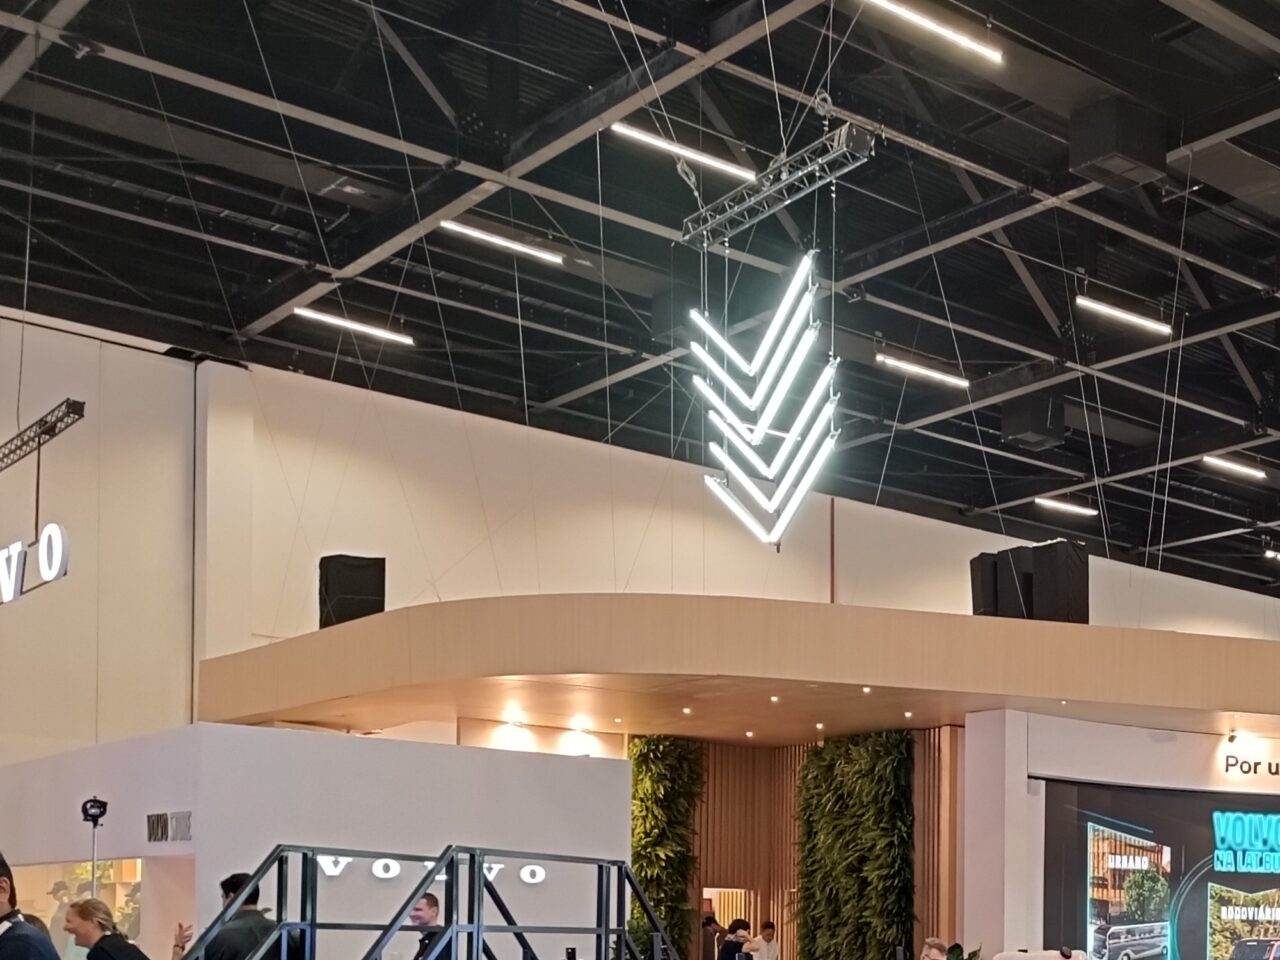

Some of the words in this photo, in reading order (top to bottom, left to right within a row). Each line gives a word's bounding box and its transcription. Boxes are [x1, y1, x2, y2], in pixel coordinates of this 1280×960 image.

[1225, 755, 1261, 775] Por
[1108, 854, 1149, 870] URBANO
[1214, 850, 1235, 871] NA
